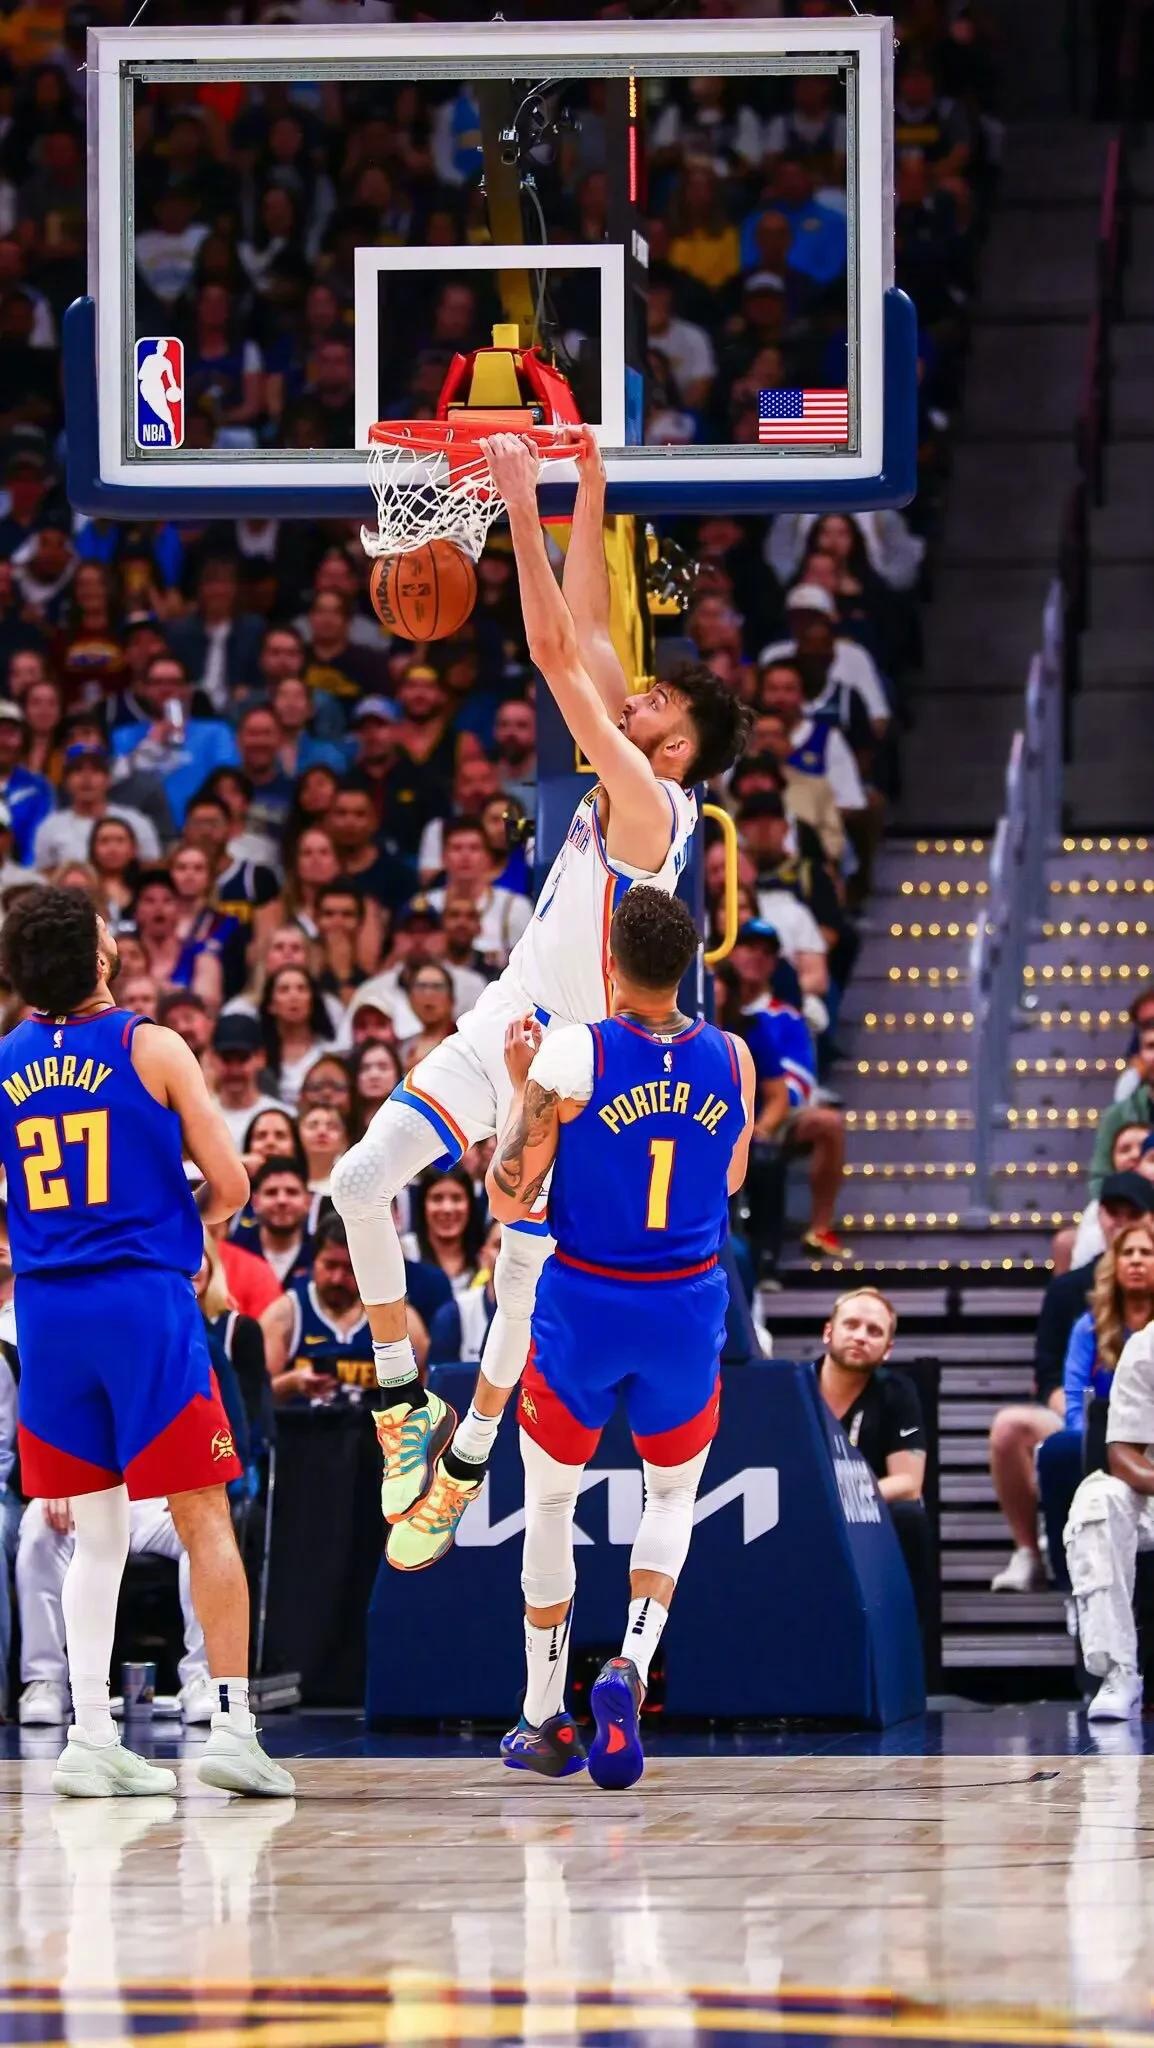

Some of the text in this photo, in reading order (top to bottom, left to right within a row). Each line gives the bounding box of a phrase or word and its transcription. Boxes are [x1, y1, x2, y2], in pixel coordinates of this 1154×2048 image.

[143, 424, 166, 442] NBA
[1, 1055, 113, 1107] MURRAY
[597, 1080, 729, 1136] PORTER JR.
[15, 1107, 110, 1213] 27
[646, 1138, 676, 1231] 1
